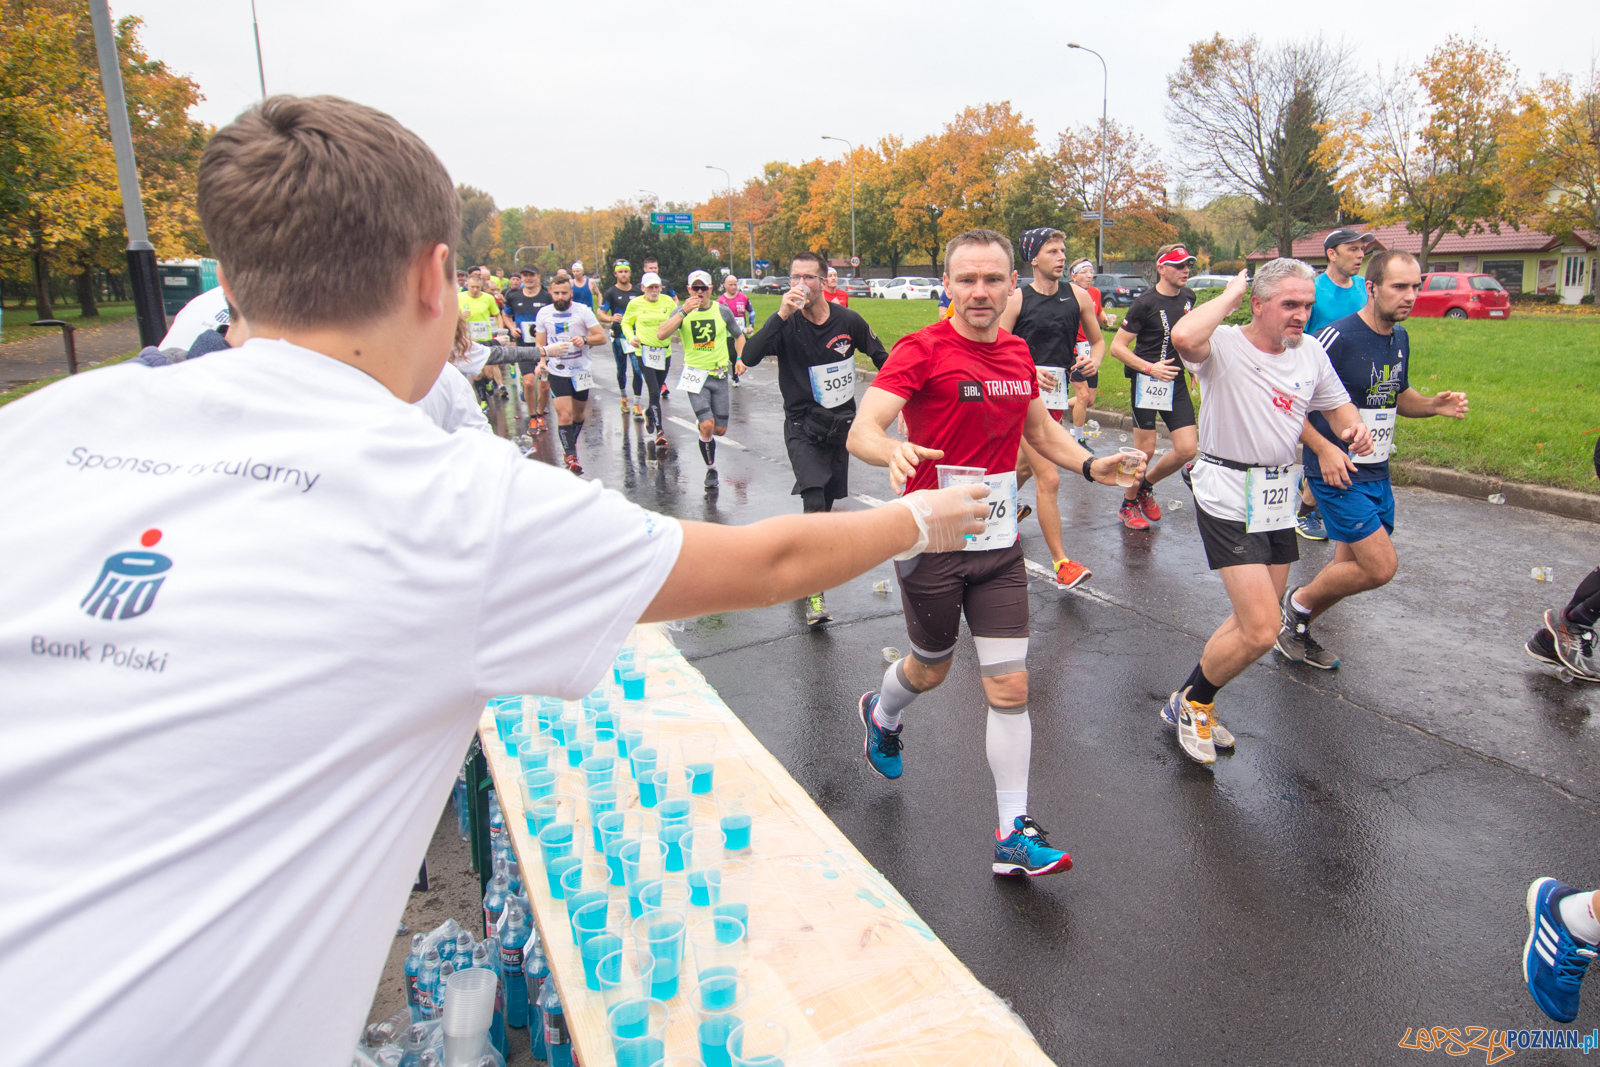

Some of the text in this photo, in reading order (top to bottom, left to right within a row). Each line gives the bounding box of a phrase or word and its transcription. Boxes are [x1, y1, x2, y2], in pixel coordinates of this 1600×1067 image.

[823, 372, 853, 392] 3035
[963, 385, 981, 397] JBL
[1145, 385, 1168, 397] 4267
[65, 446, 181, 477] Sponsor
[1262, 486, 1289, 506] 1221
[983, 499, 1006, 520] 76
[31, 635, 168, 673] Bank Polski
